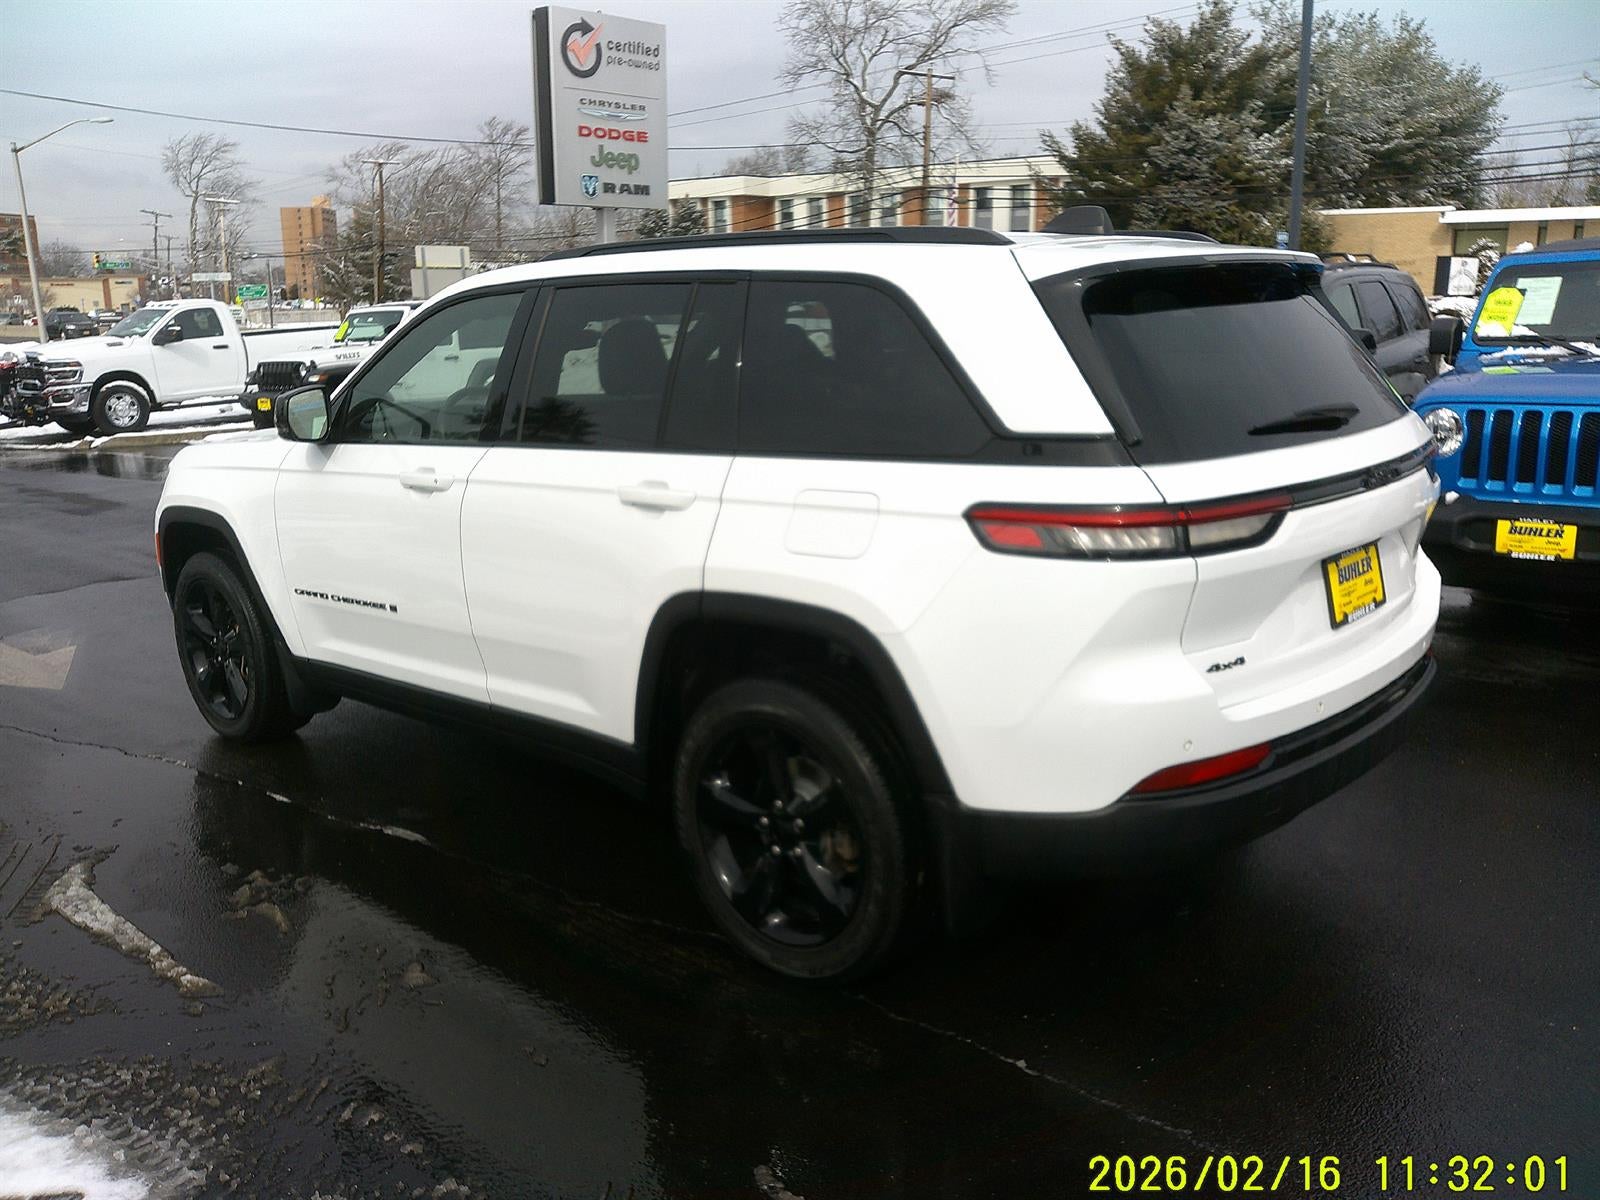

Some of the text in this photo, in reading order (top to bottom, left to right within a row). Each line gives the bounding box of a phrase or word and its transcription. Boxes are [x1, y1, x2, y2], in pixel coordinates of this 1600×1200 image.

[607, 40, 660, 58] certified
[606, 55, 660, 72] pre-owned
[579, 97, 647, 112] CHRYSLER
[578, 125, 649, 143] DODGE
[590, 144, 640, 174] Jeep
[602, 181, 650, 196] RAM
[1508, 525, 1565, 539] BUHLER
[1338, 556, 1373, 585] BUHLER
[1206, 656, 1246, 673] 4x4
